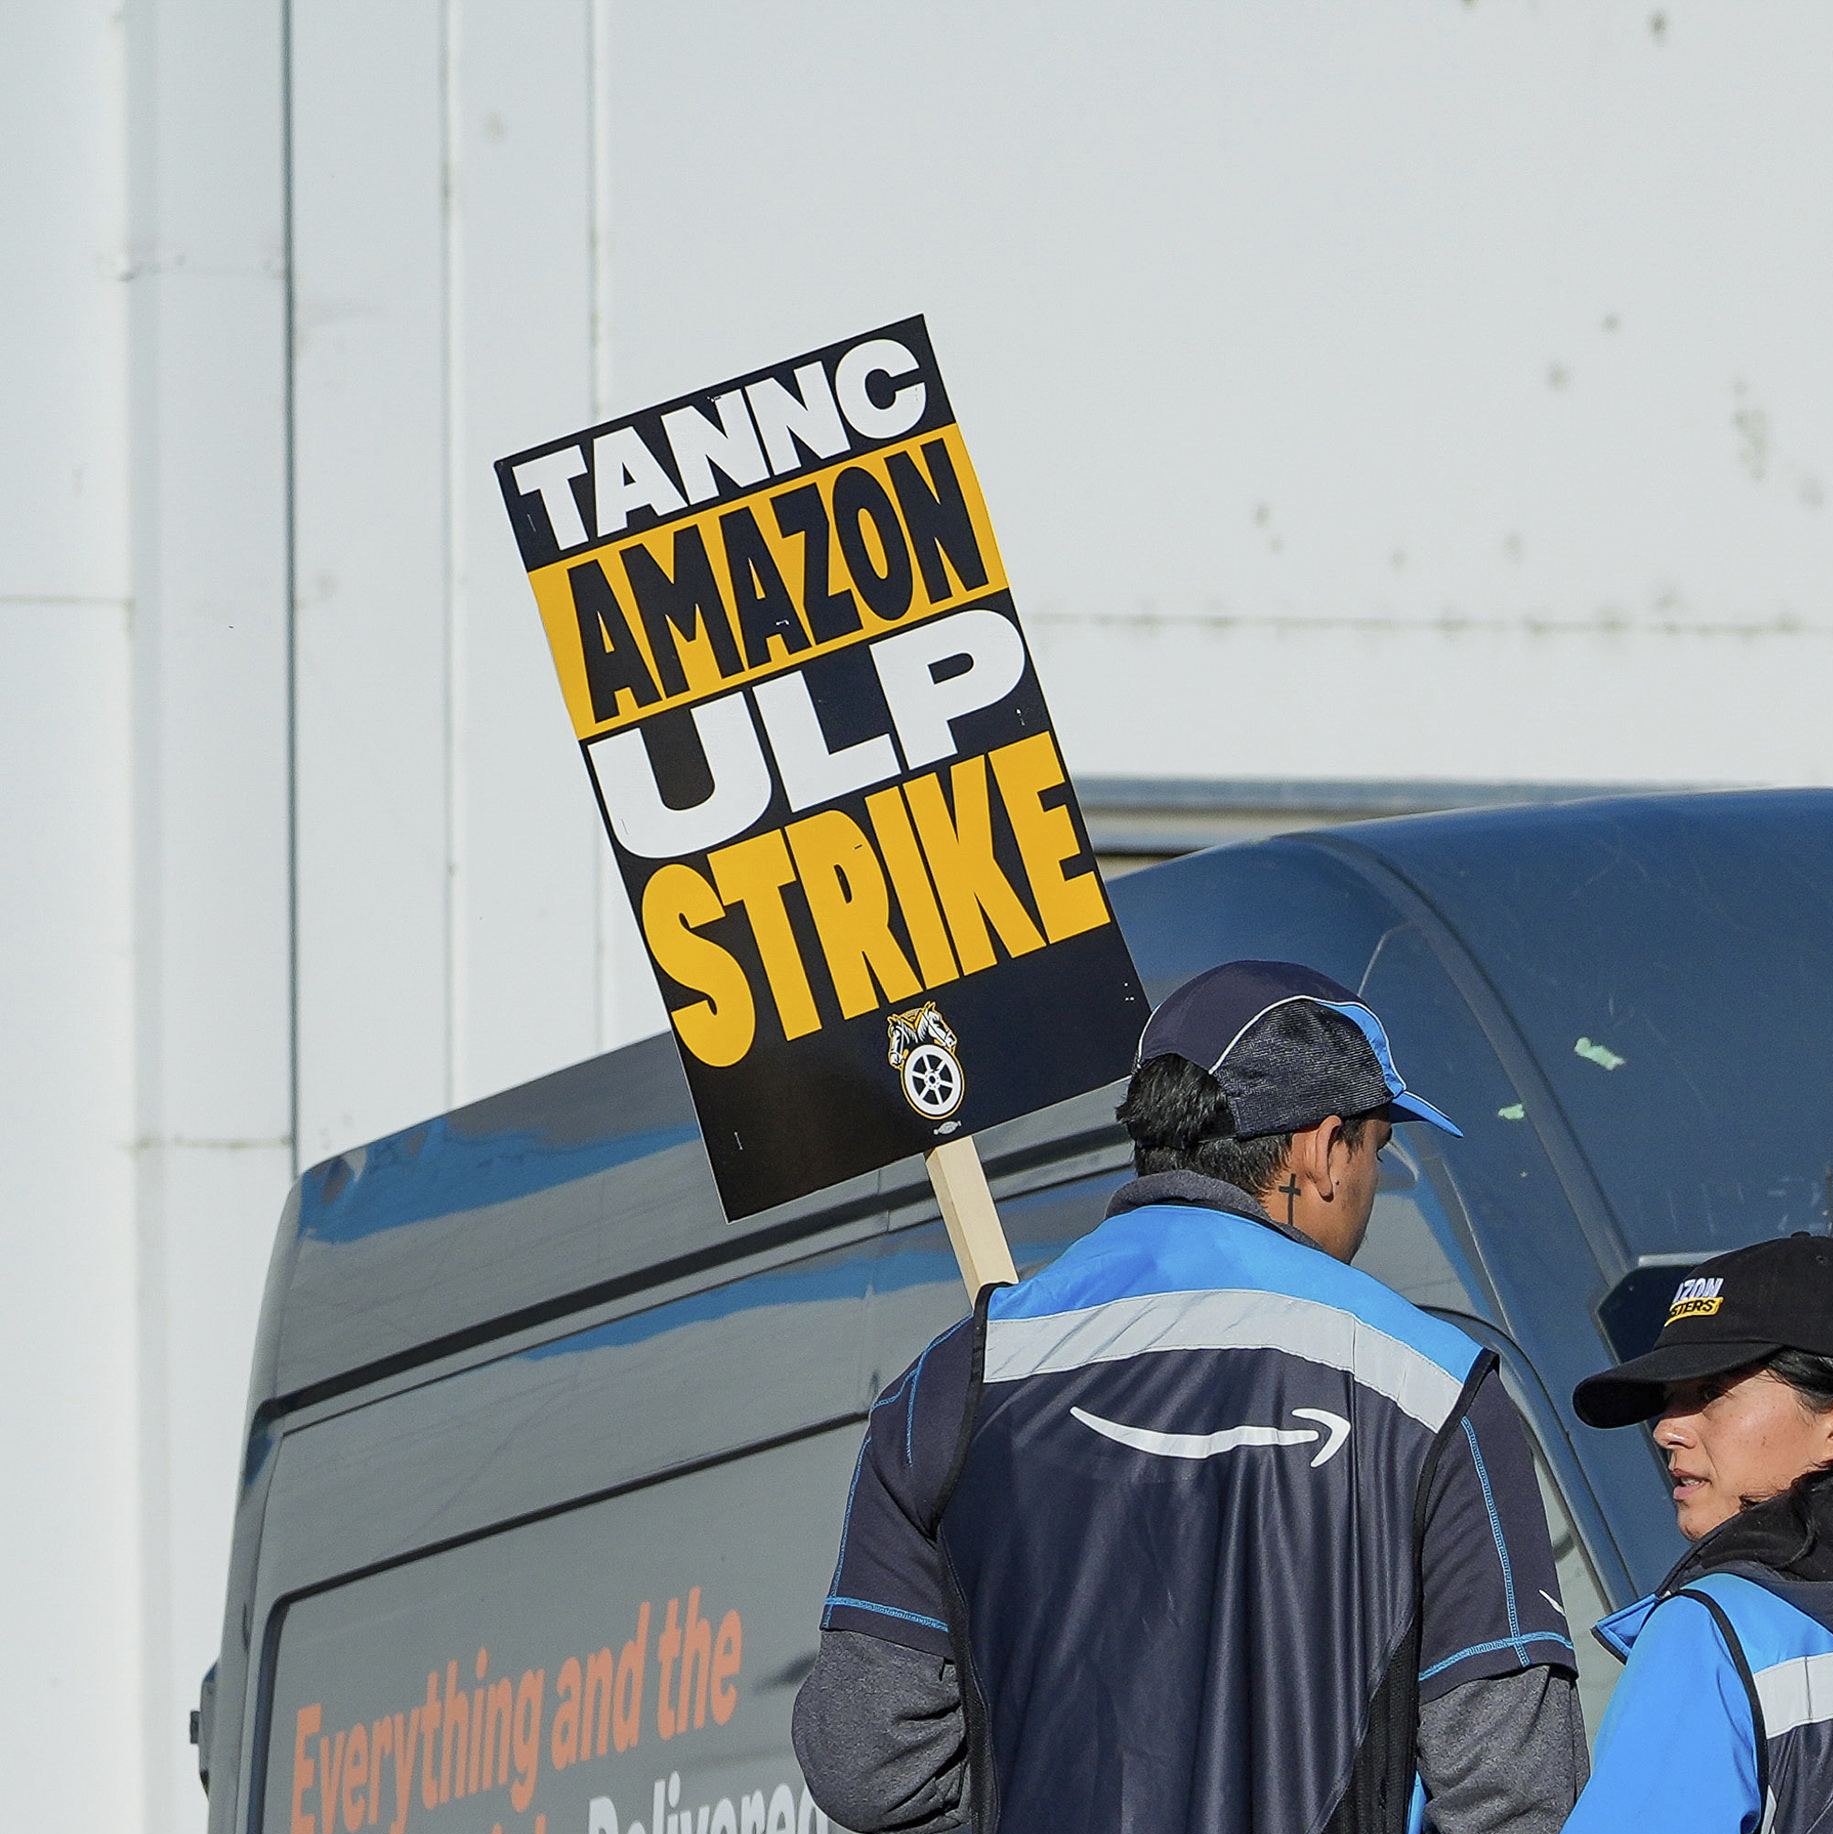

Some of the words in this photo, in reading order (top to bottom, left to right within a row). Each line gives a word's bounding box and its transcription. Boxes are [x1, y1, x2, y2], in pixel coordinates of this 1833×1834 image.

[512, 337, 927, 552] TANNC
[566, 437, 989, 724] AMAZON
[587, 608, 1027, 859] ULP
[641, 730, 1112, 1069] STRIKE
[551, 1600, 650, 1771] and
[657, 1586, 743, 1741] the
